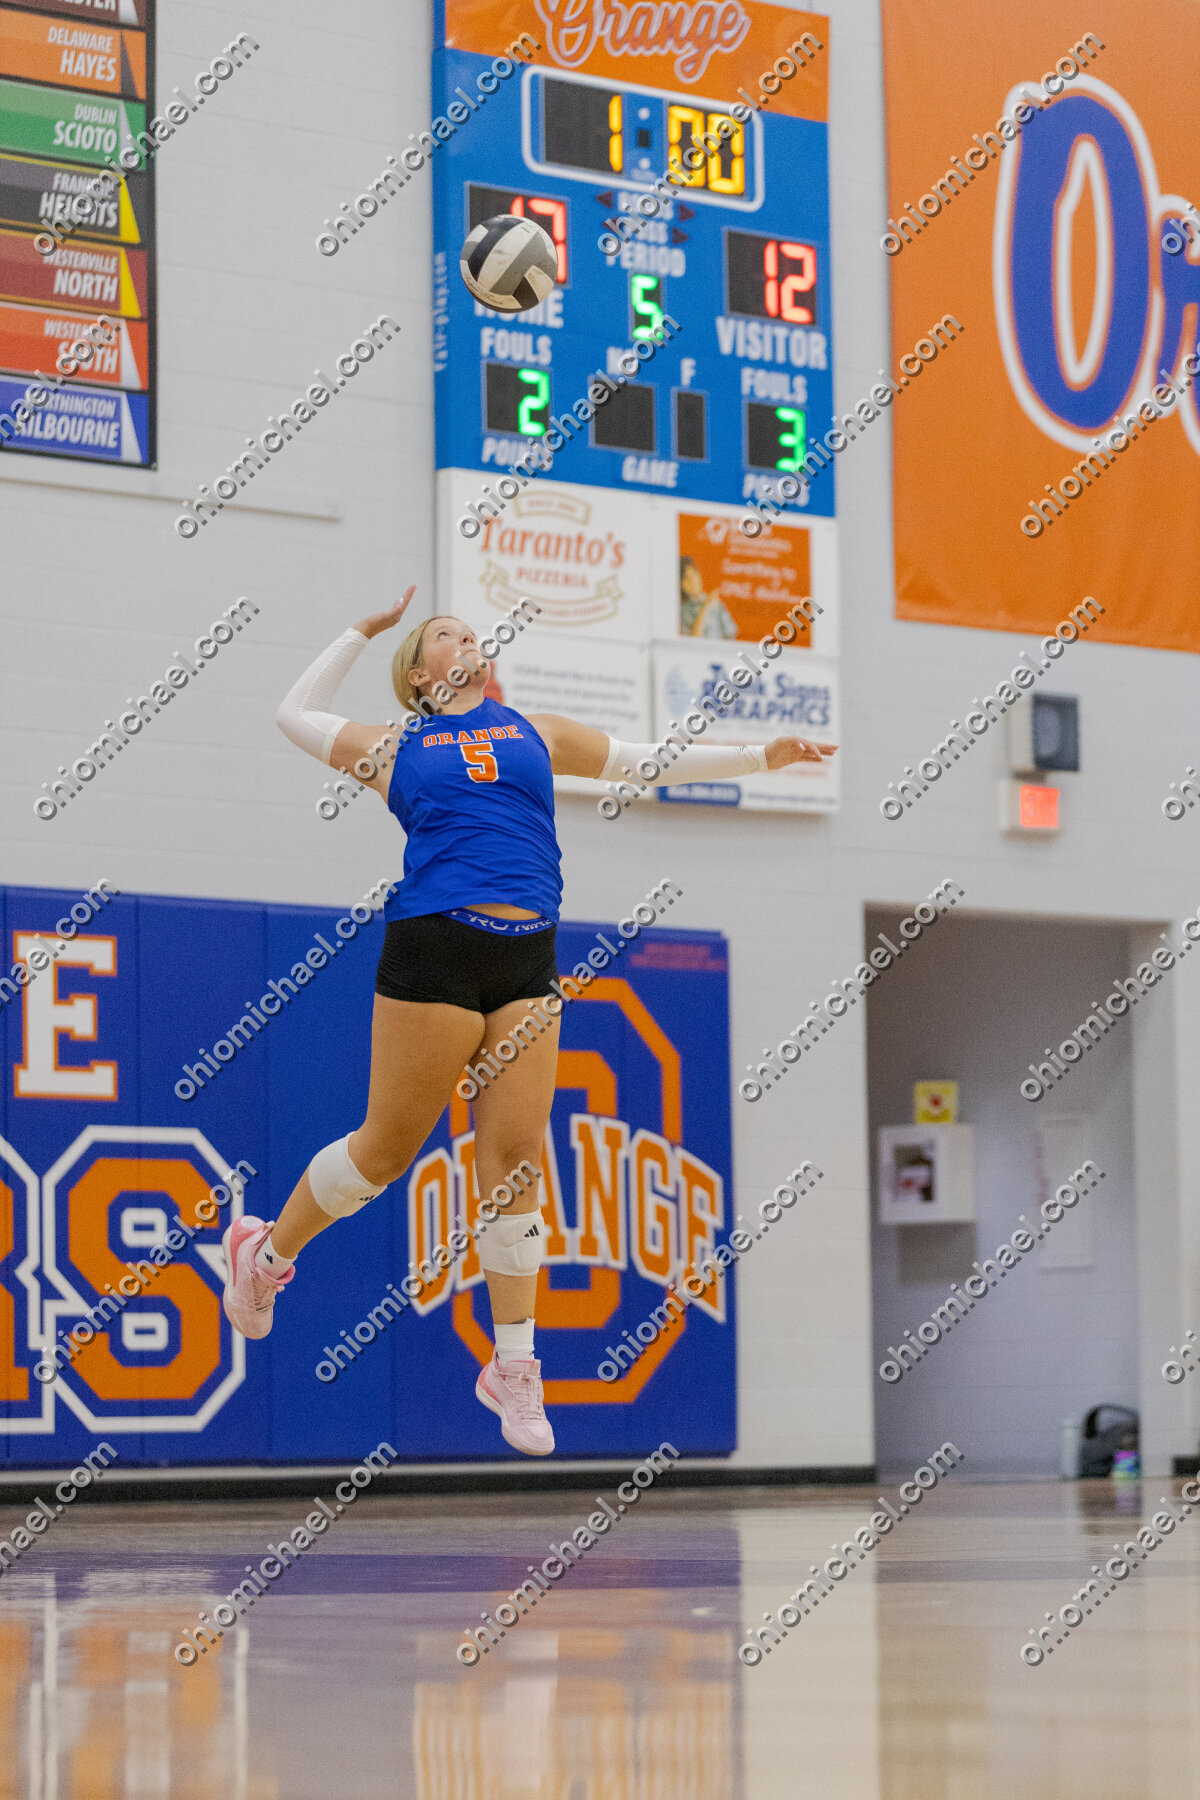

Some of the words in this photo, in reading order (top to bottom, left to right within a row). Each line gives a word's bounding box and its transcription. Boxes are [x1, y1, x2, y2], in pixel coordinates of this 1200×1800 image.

[47, 26, 114, 54] DELAWARE
[59, 49, 117, 82] HAYES
[73, 103, 118, 126] DUBLIN
[52, 119, 119, 154] SCIOTO
[763, 240, 818, 324] 12
[993, 72, 1200, 455] Or
[53, 268, 119, 303] NORTH
[630, 273, 665, 341] 5
[480, 327, 552, 365] FOULS
[715, 315, 828, 370] VISITOR
[680, 358, 696, 386] F
[741, 367, 808, 404] FOULS
[518, 368, 550, 437] 2
[775, 406, 806, 473] 3
[621, 456, 680, 488] GAME
[480, 516, 627, 568] Taranto's
[422, 725, 524, 748] ORANGE
[459, 742, 500, 784] 5
[13, 930, 119, 1100] E
